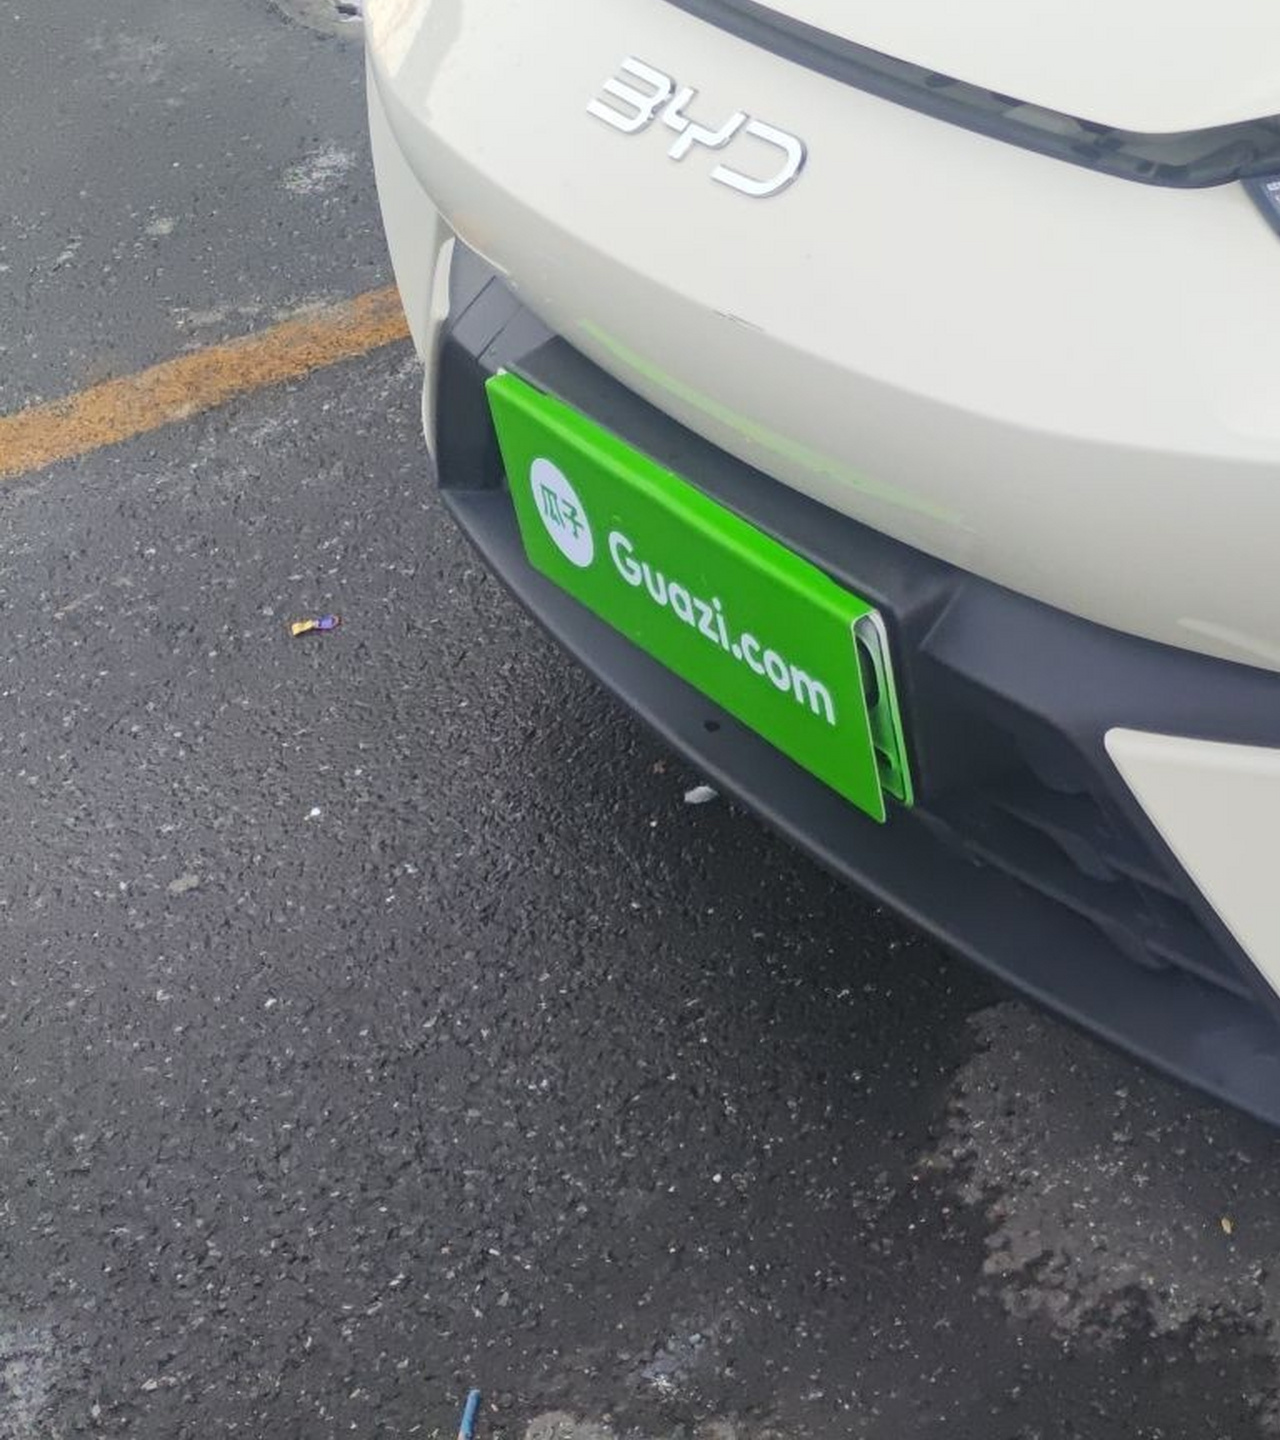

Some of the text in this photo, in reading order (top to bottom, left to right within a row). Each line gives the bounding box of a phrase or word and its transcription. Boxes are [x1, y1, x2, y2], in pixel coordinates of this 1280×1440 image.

[585, 54, 810, 200] BYD
[539, 480, 587, 543] 瓜子
[607, 530, 838, 728] Guazi.com
